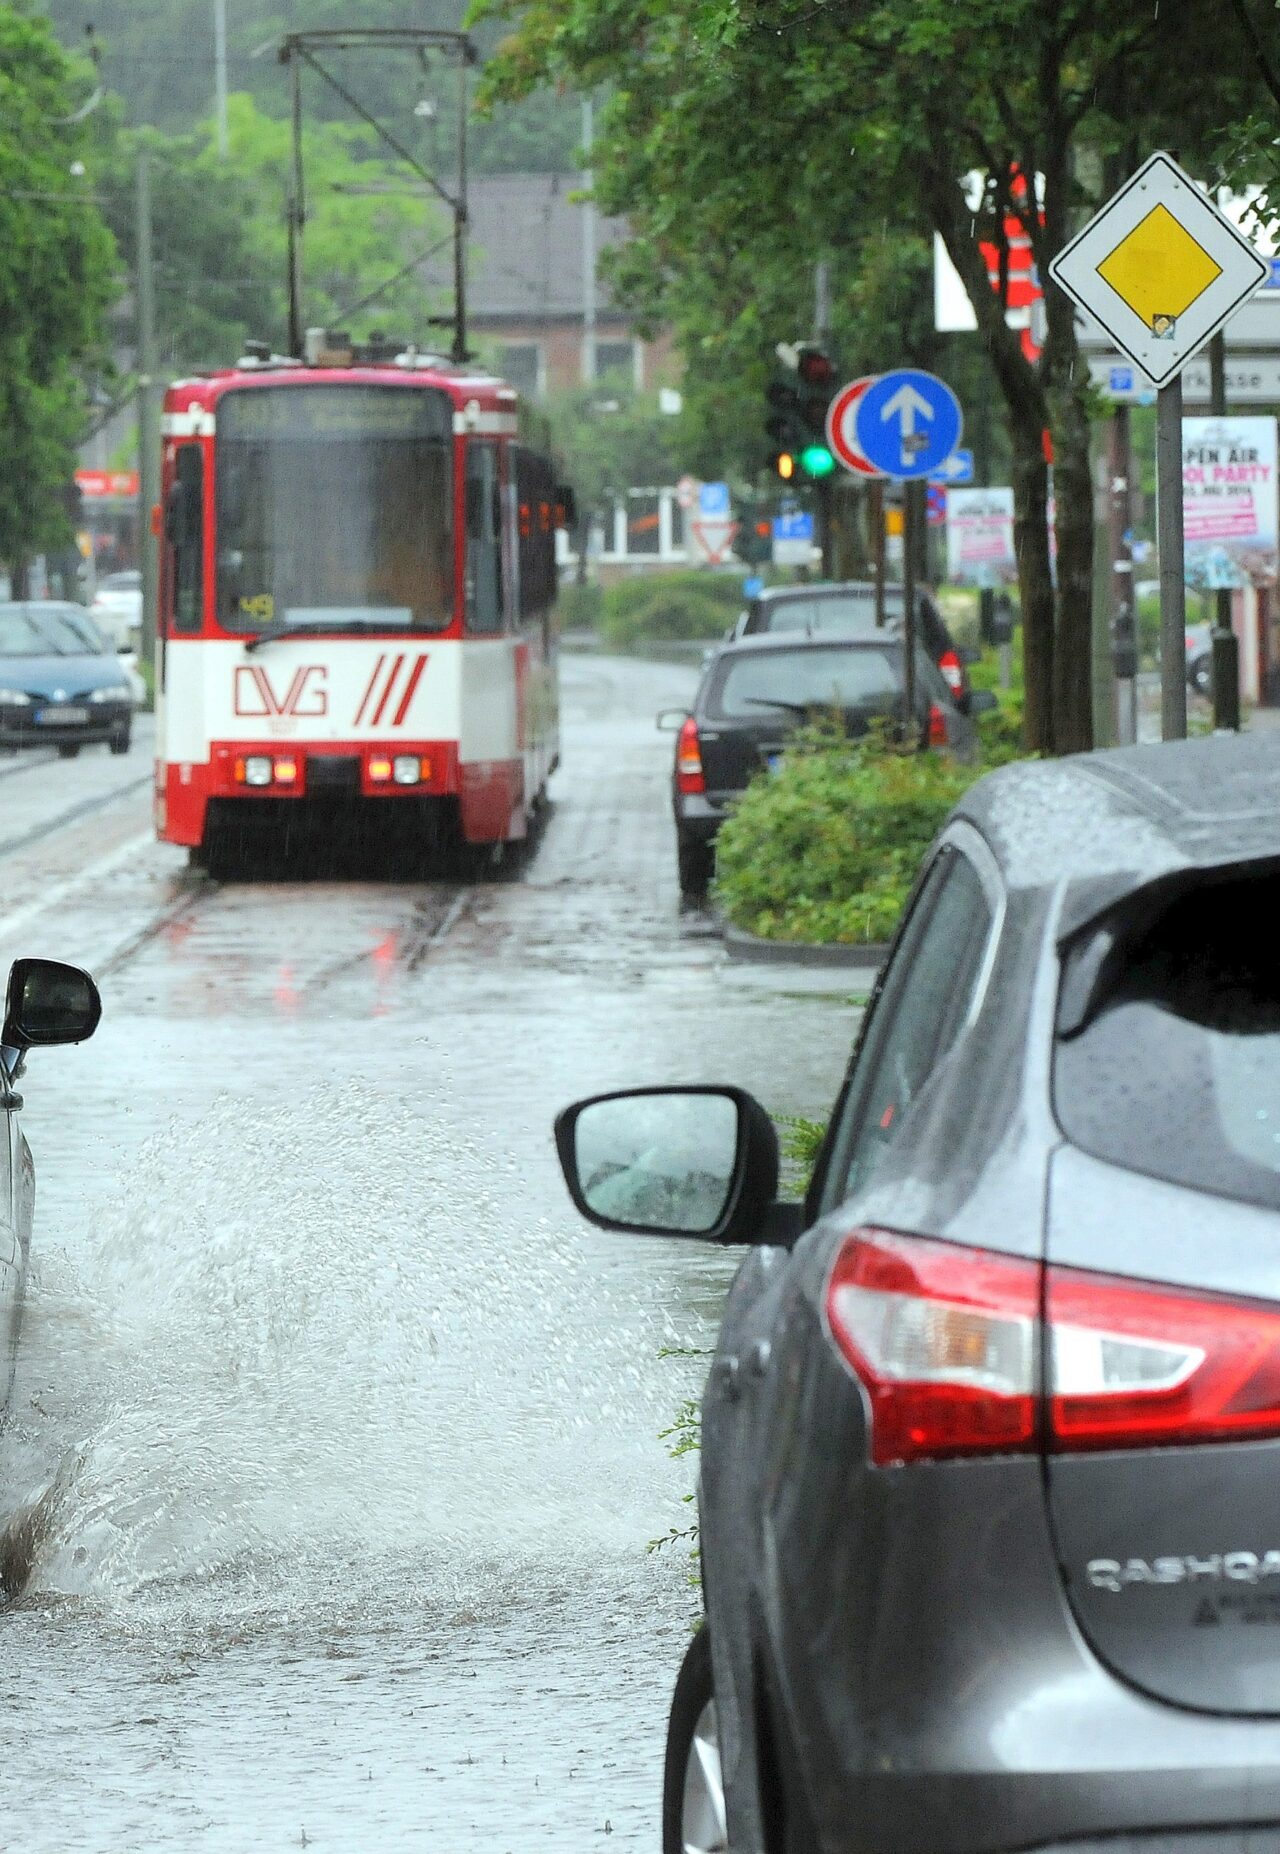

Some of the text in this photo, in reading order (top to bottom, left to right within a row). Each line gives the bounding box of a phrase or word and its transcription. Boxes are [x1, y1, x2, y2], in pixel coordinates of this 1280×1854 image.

[1183, 449, 1219, 464] PEN
[1213, 464, 1270, 482] PARTY
[234, 666, 328, 717] DVG
